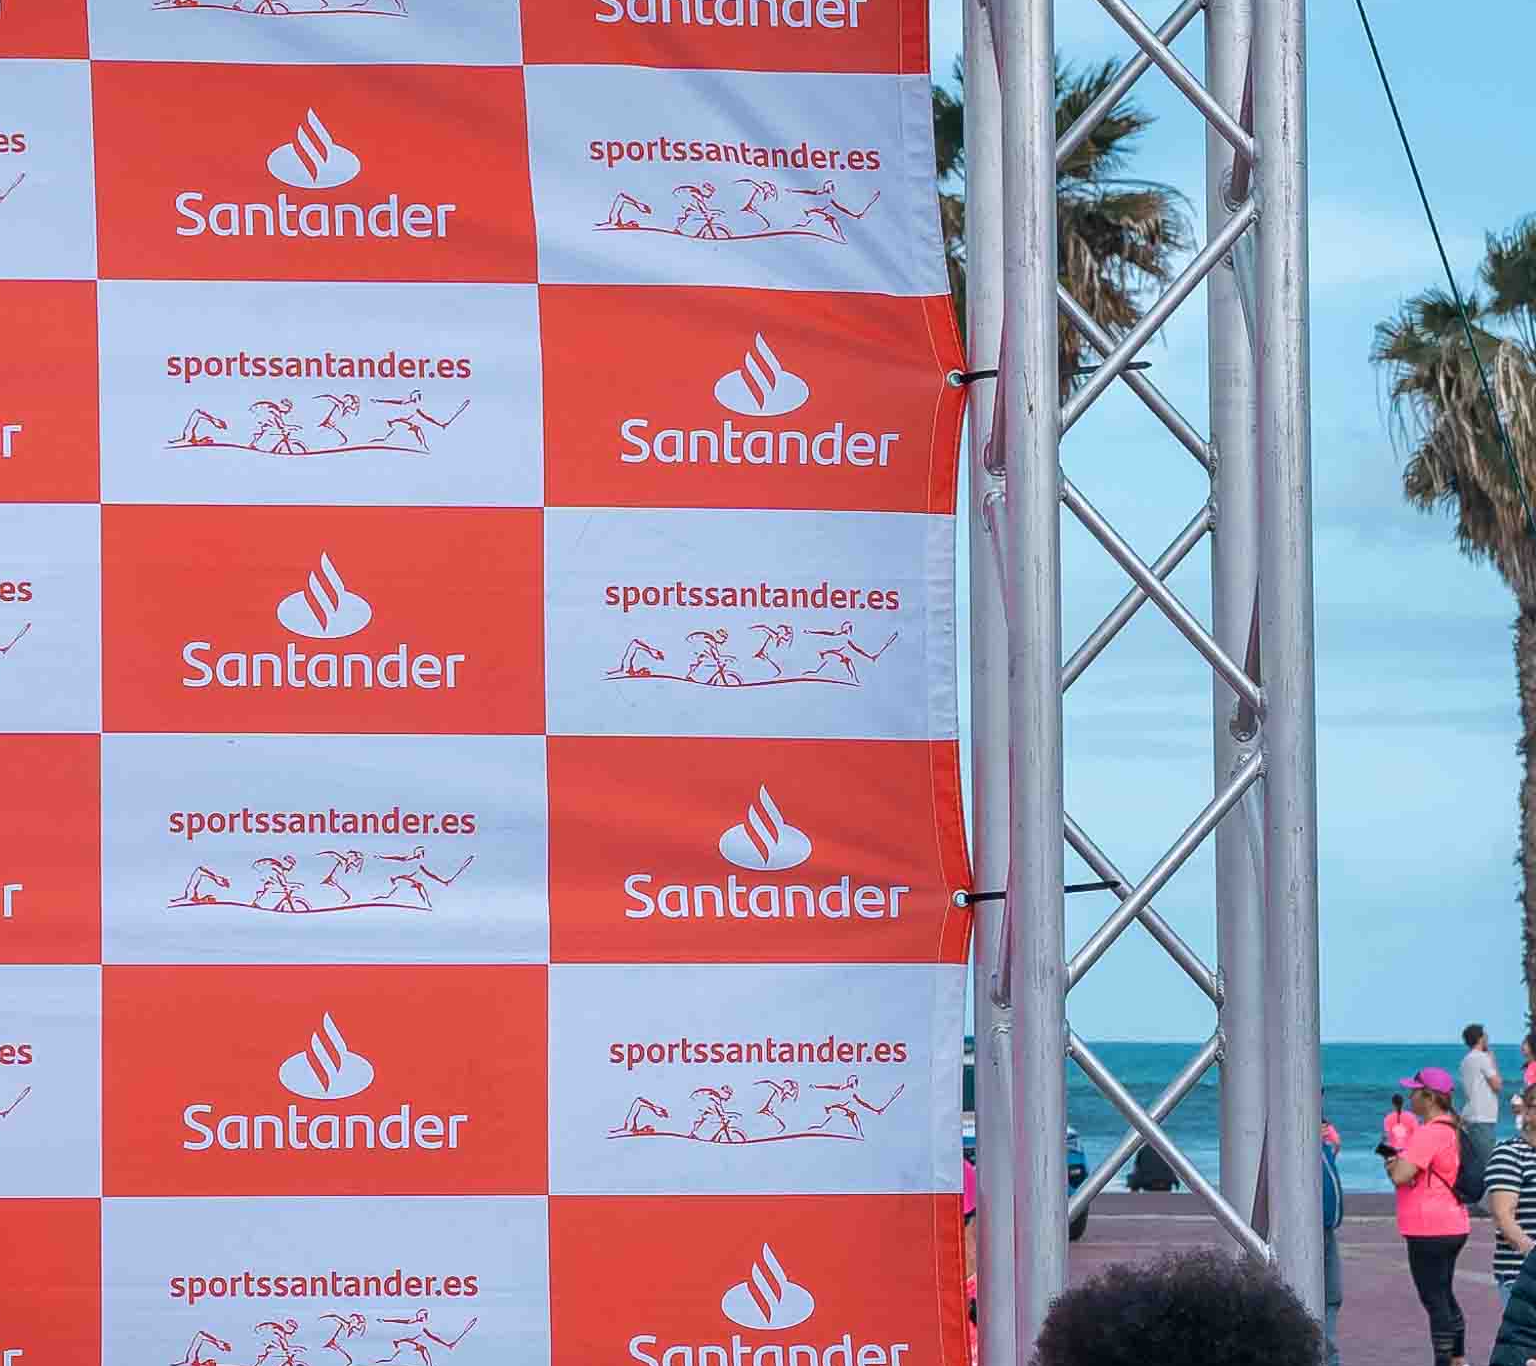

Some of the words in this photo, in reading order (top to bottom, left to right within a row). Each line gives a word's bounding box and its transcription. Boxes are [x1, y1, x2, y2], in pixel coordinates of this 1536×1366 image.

[589, 136, 881, 171] sportssantander.es
[175, 192, 457, 238] Santander
[167, 351, 471, 384] sportssantander.es
[620, 418, 900, 467] Santander
[605, 581, 900, 613] sportssantander.es
[182, 641, 465, 689] Santander
[169, 806, 476, 841] sportssantander.es
[624, 874, 910, 918] Santander
[610, 1034, 907, 1070] sportssantander.es
[183, 1104, 468, 1150] Santander
[170, 1269, 479, 1305] sportssantander.es
